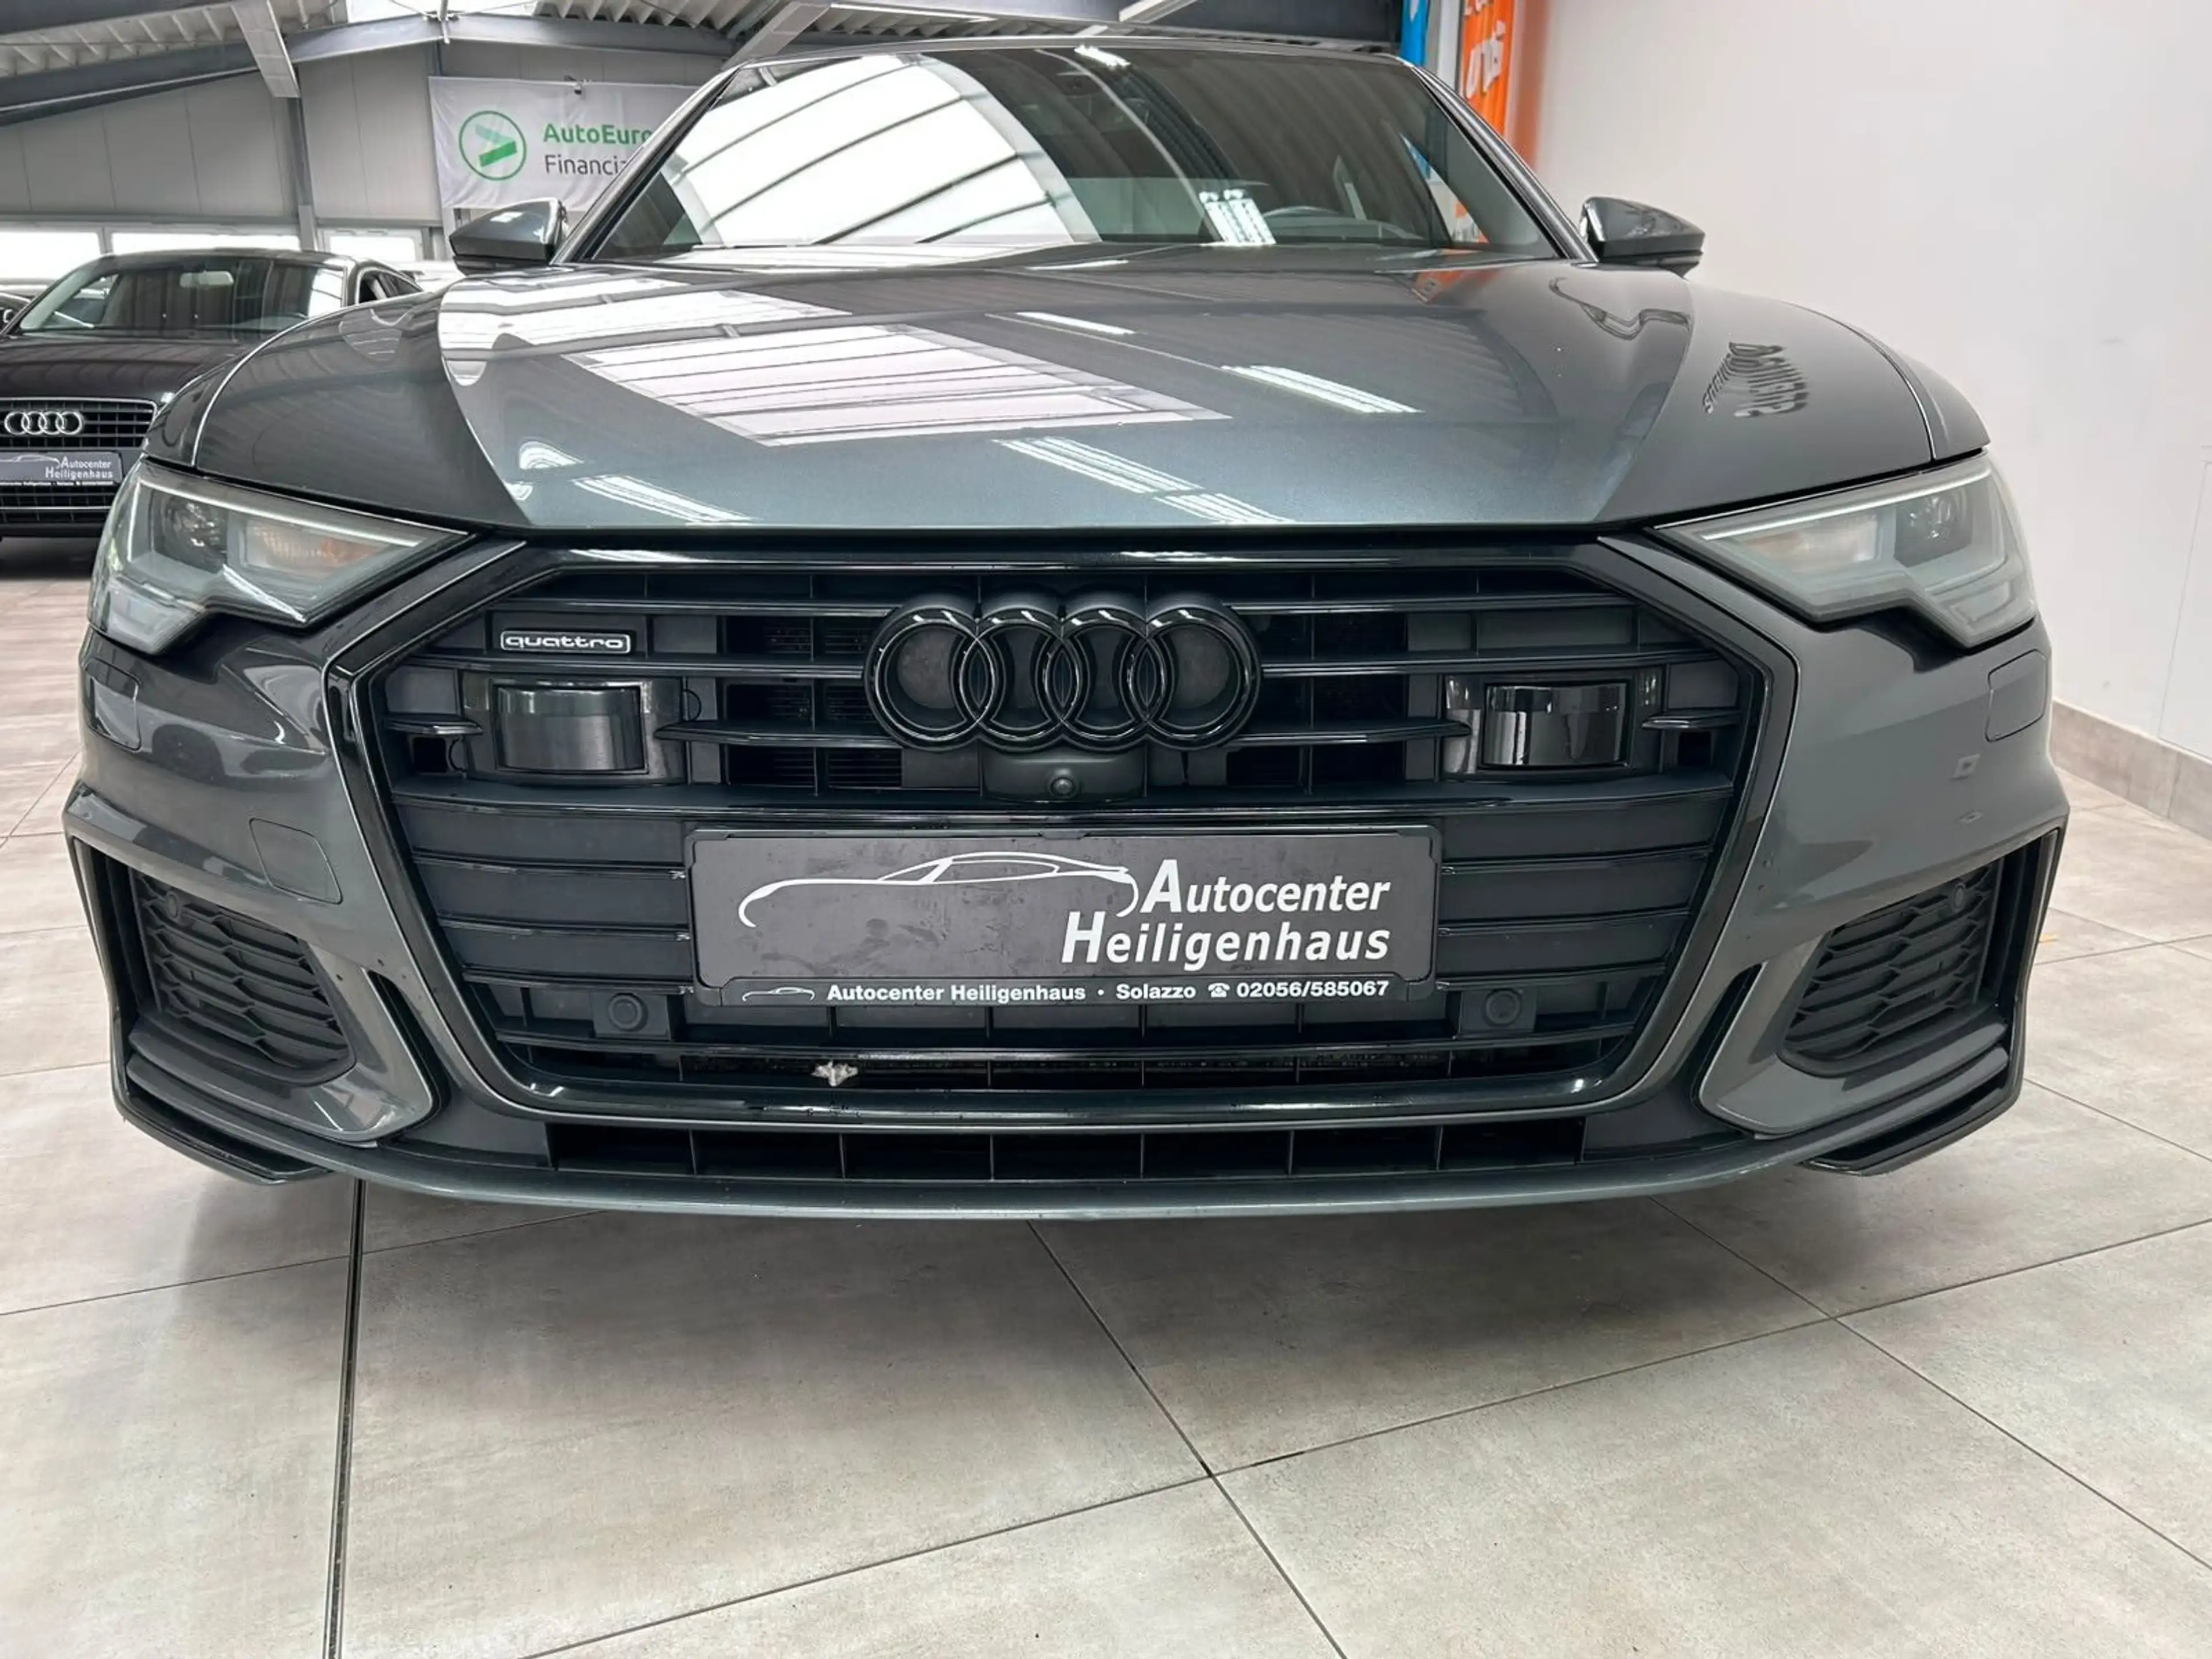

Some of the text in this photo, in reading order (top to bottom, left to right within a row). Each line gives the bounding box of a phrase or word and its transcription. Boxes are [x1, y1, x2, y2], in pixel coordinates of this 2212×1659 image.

[545, 154, 627, 175] Financi
[60, 456, 112, 468] Autocenter
[46, 466, 113, 480] Heiligenhaus
[506, 636, 623, 649] quattro
[1140, 859, 1391, 914] Autocenter
[1061, 911, 1391, 971] Heiligenhaus
[827, 980, 1389, 1004] Autocenter Heiligenhaus Solazzo 02056/585067
